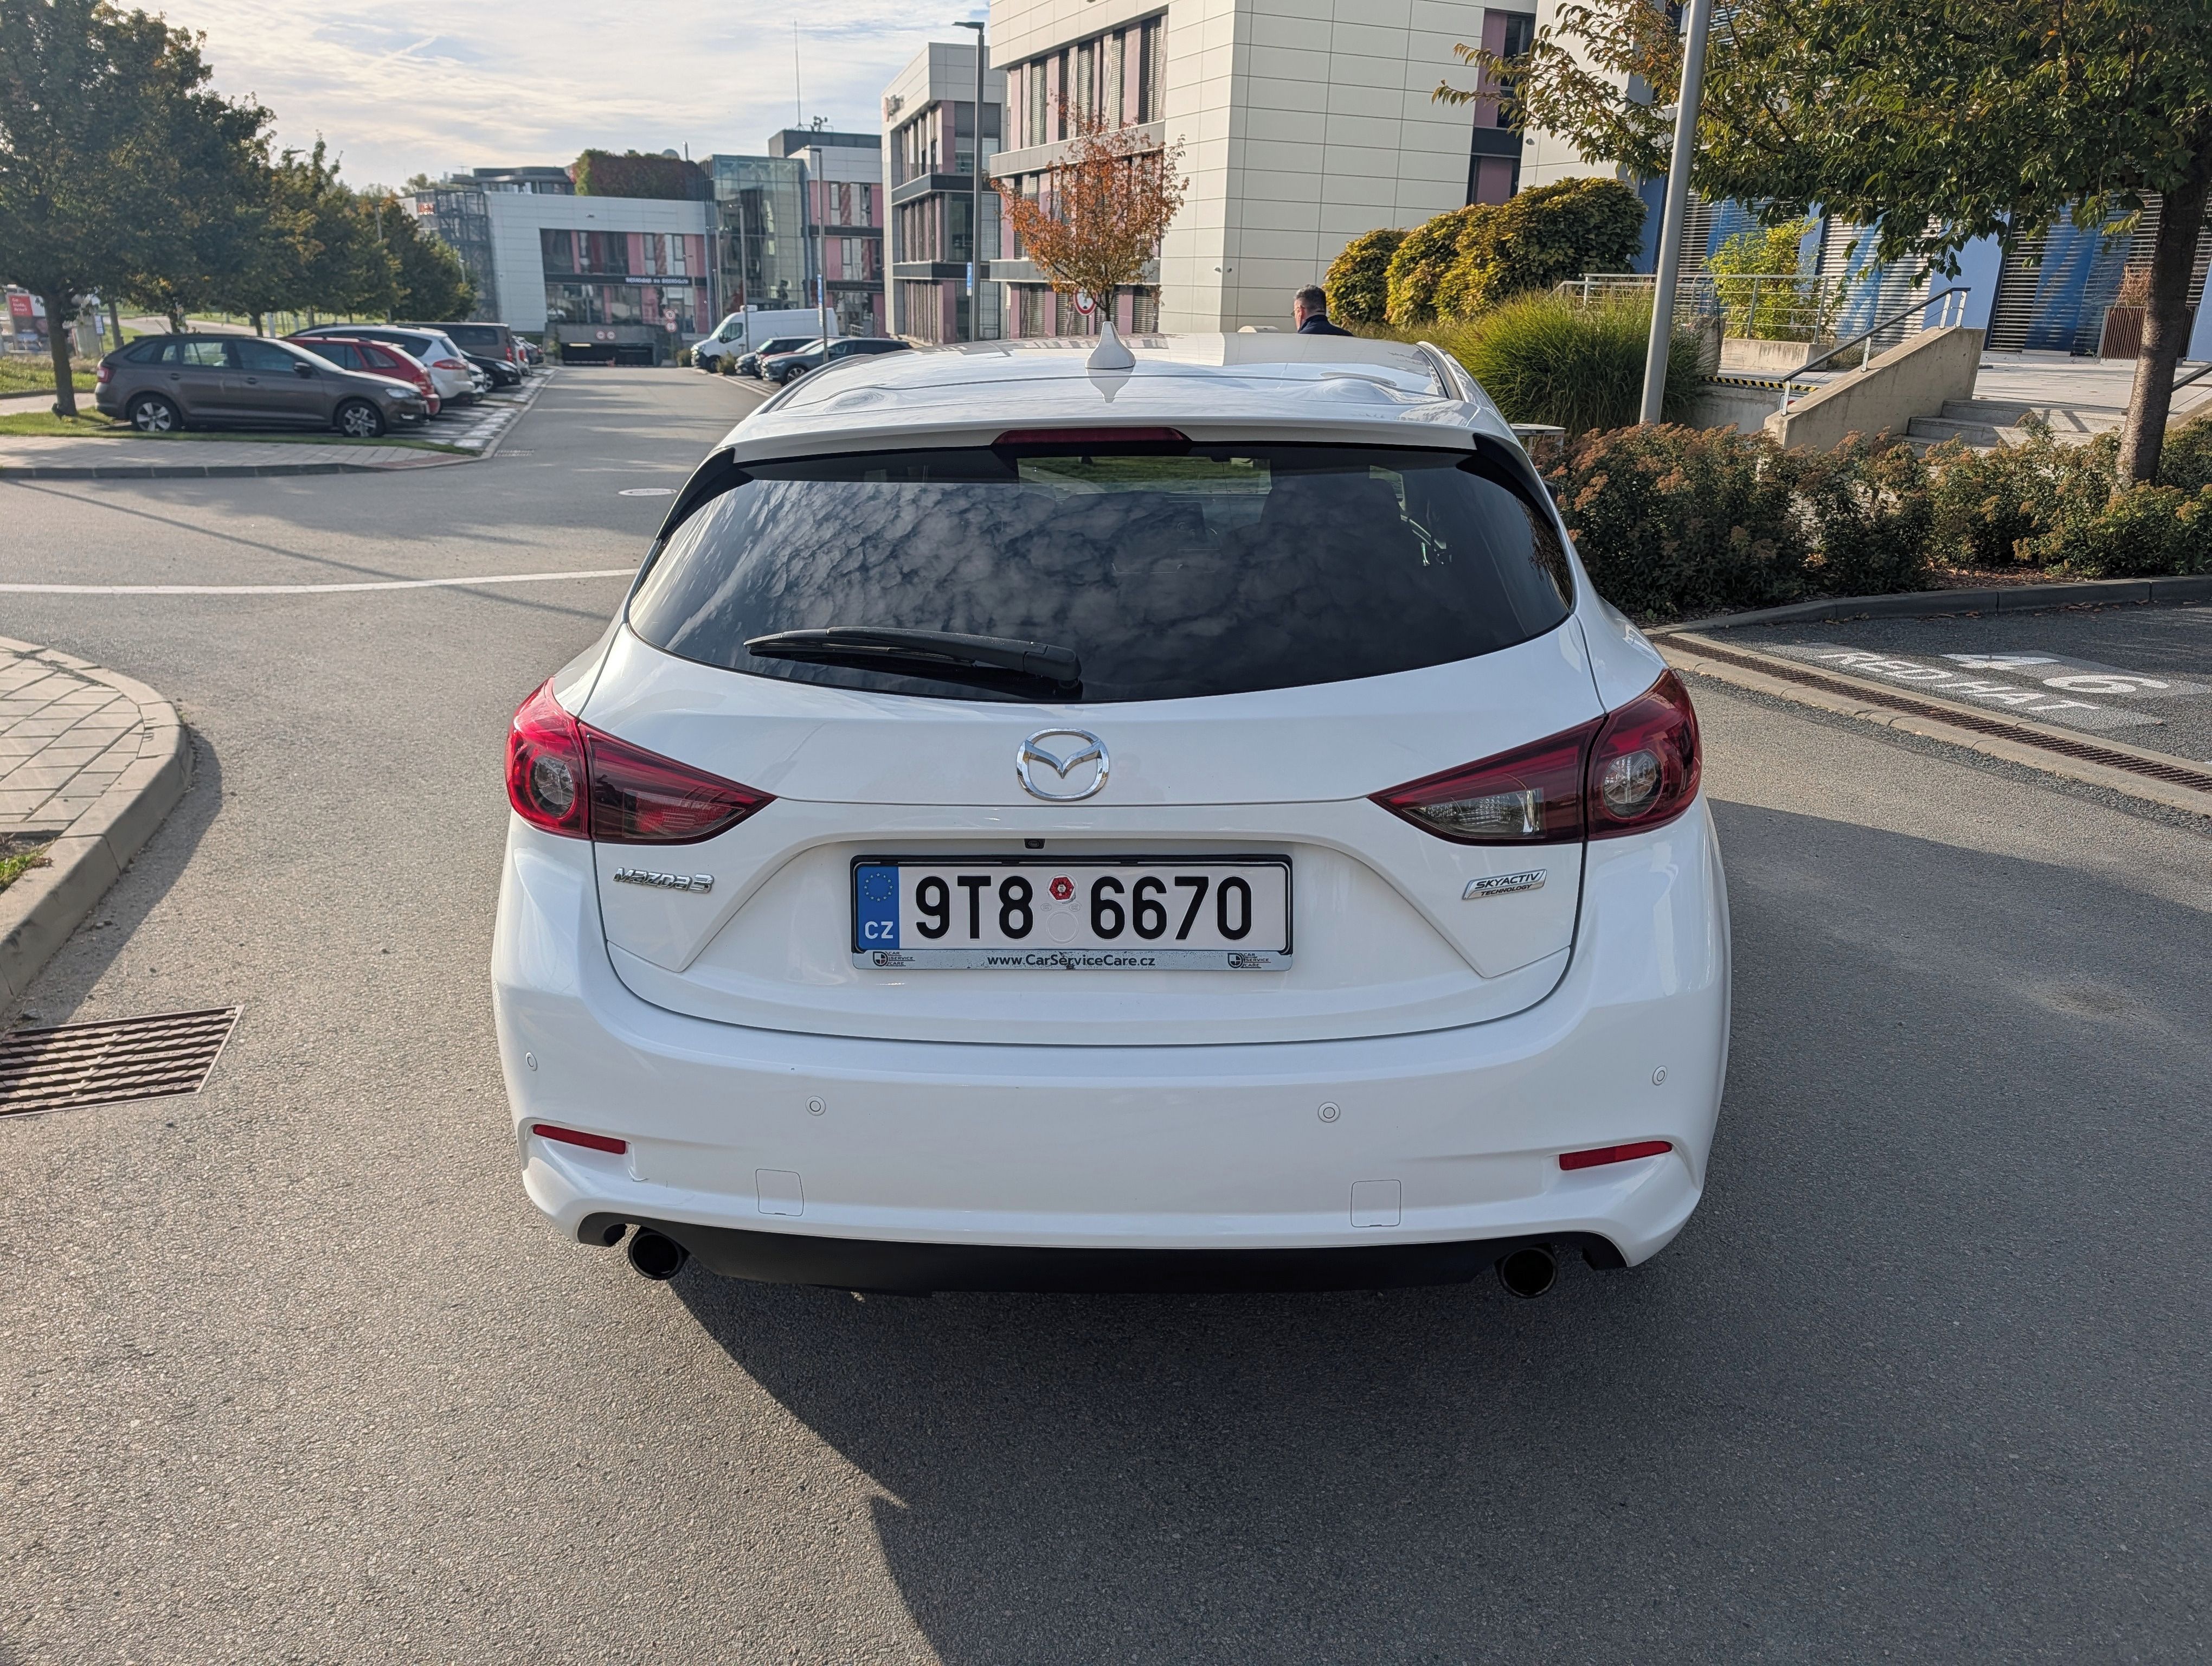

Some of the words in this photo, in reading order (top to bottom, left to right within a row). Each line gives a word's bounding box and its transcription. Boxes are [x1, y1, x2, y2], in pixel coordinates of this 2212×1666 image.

[1819, 652, 1953, 680] RED
[1935, 681, 2100, 710] HAT
[1475, 873, 1540, 889] SKYACTIV
[1481, 884, 1533, 896] TECHNOLOGY
[865, 921, 893, 939] CZ
[916, 875, 1033, 939] 9T8
[1091, 876, 1252, 940] 6670
[987, 954, 1155, 967] www.CarServiceCare.cz
